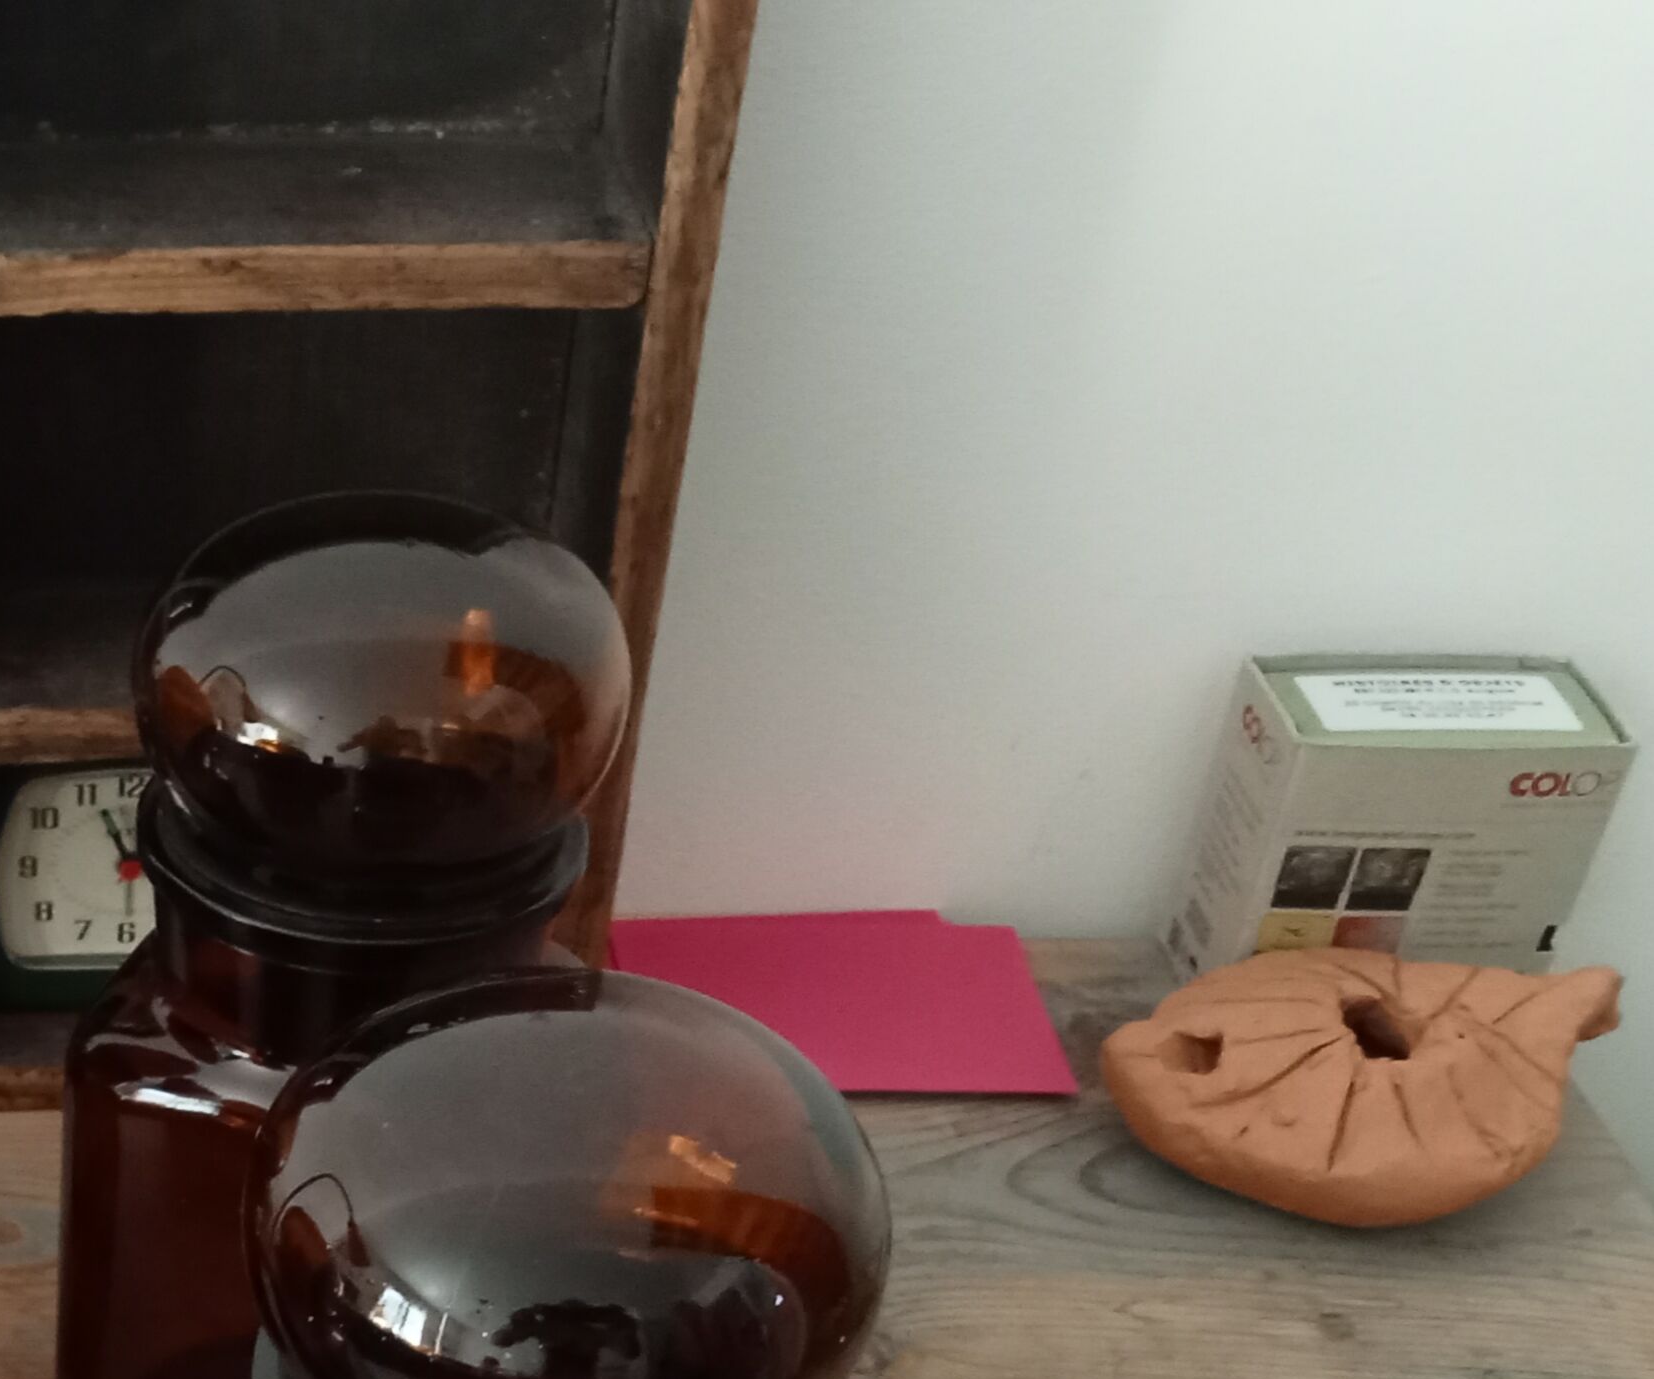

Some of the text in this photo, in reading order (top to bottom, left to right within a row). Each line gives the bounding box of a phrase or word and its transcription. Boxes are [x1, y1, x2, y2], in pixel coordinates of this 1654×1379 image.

[76, 784, 98, 806] 11
[118, 775, 145, 798] 12
[30, 807, 59, 830] 10
[18, 855, 38, 878] 9
[35, 901, 53, 921] 8
[75, 920, 93, 941] 7
[117, 922, 136, 943] 6
